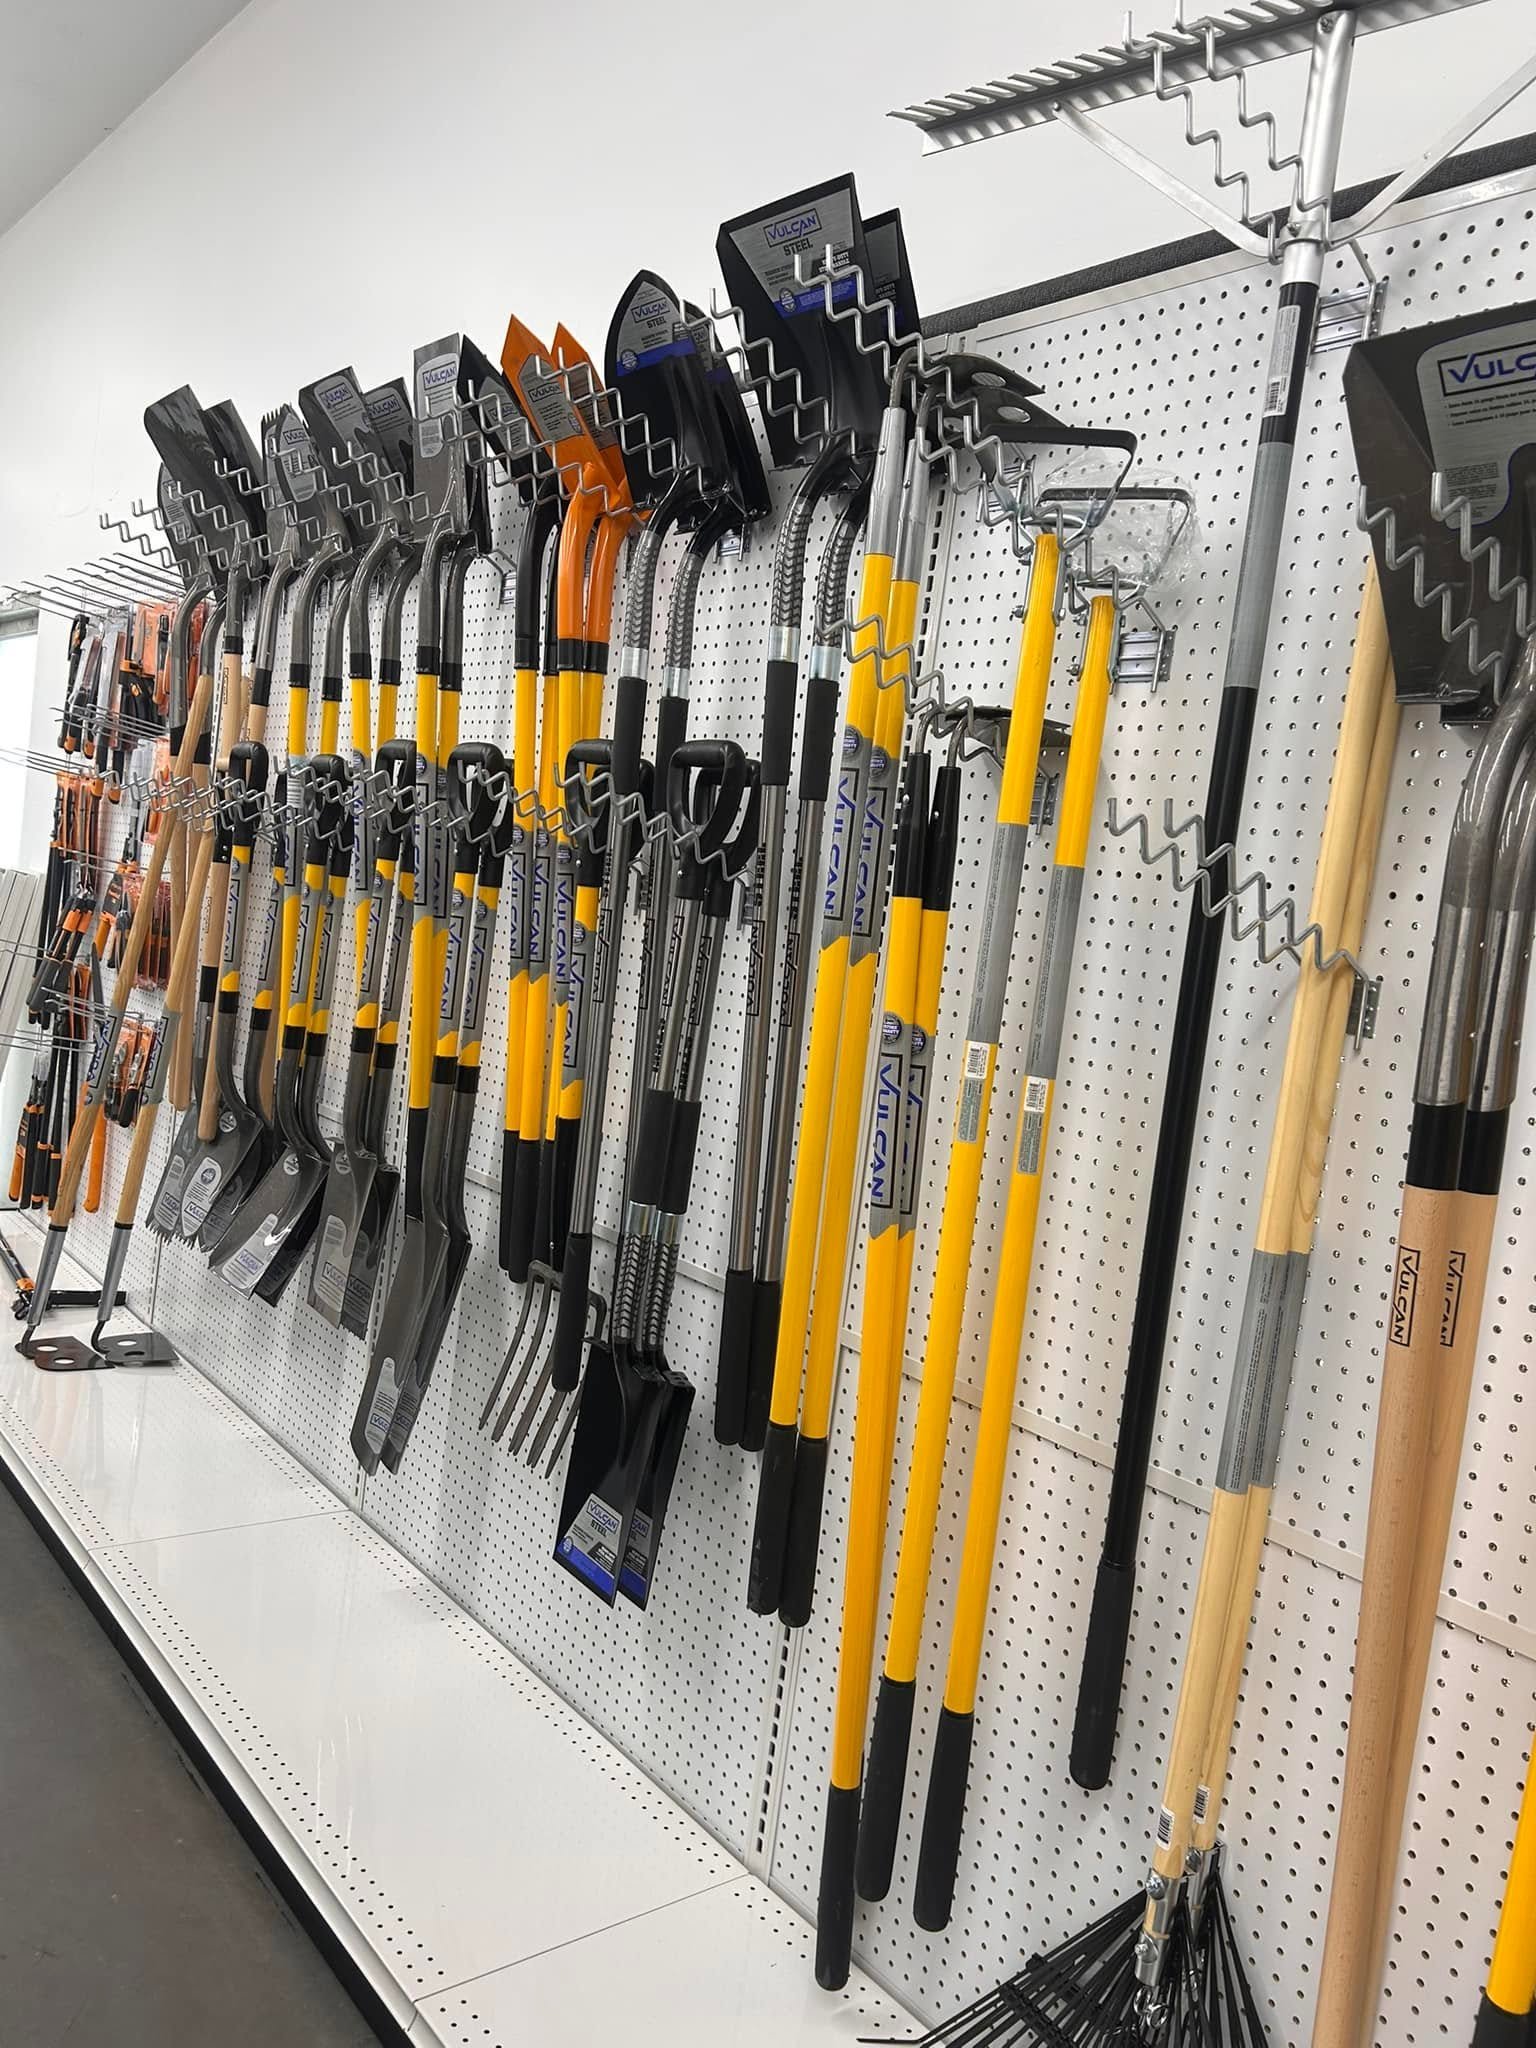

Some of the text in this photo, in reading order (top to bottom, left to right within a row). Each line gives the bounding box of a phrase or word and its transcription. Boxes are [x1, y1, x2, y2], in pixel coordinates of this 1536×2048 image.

[767, 214, 817, 240] VULCAN
[783, 238, 813, 256] STEEL
[647, 317, 666, 328] STEEL
[1448, 352, 1536, 383] VULC
[556, 880, 574, 978] VULCAN
[871, 1062, 901, 1198] VULCAN
[1393, 1255, 1418, 1338] VULCAN
[590, 1519, 608, 1538] STEEL
[591, 1503, 617, 1530] VULCAN
